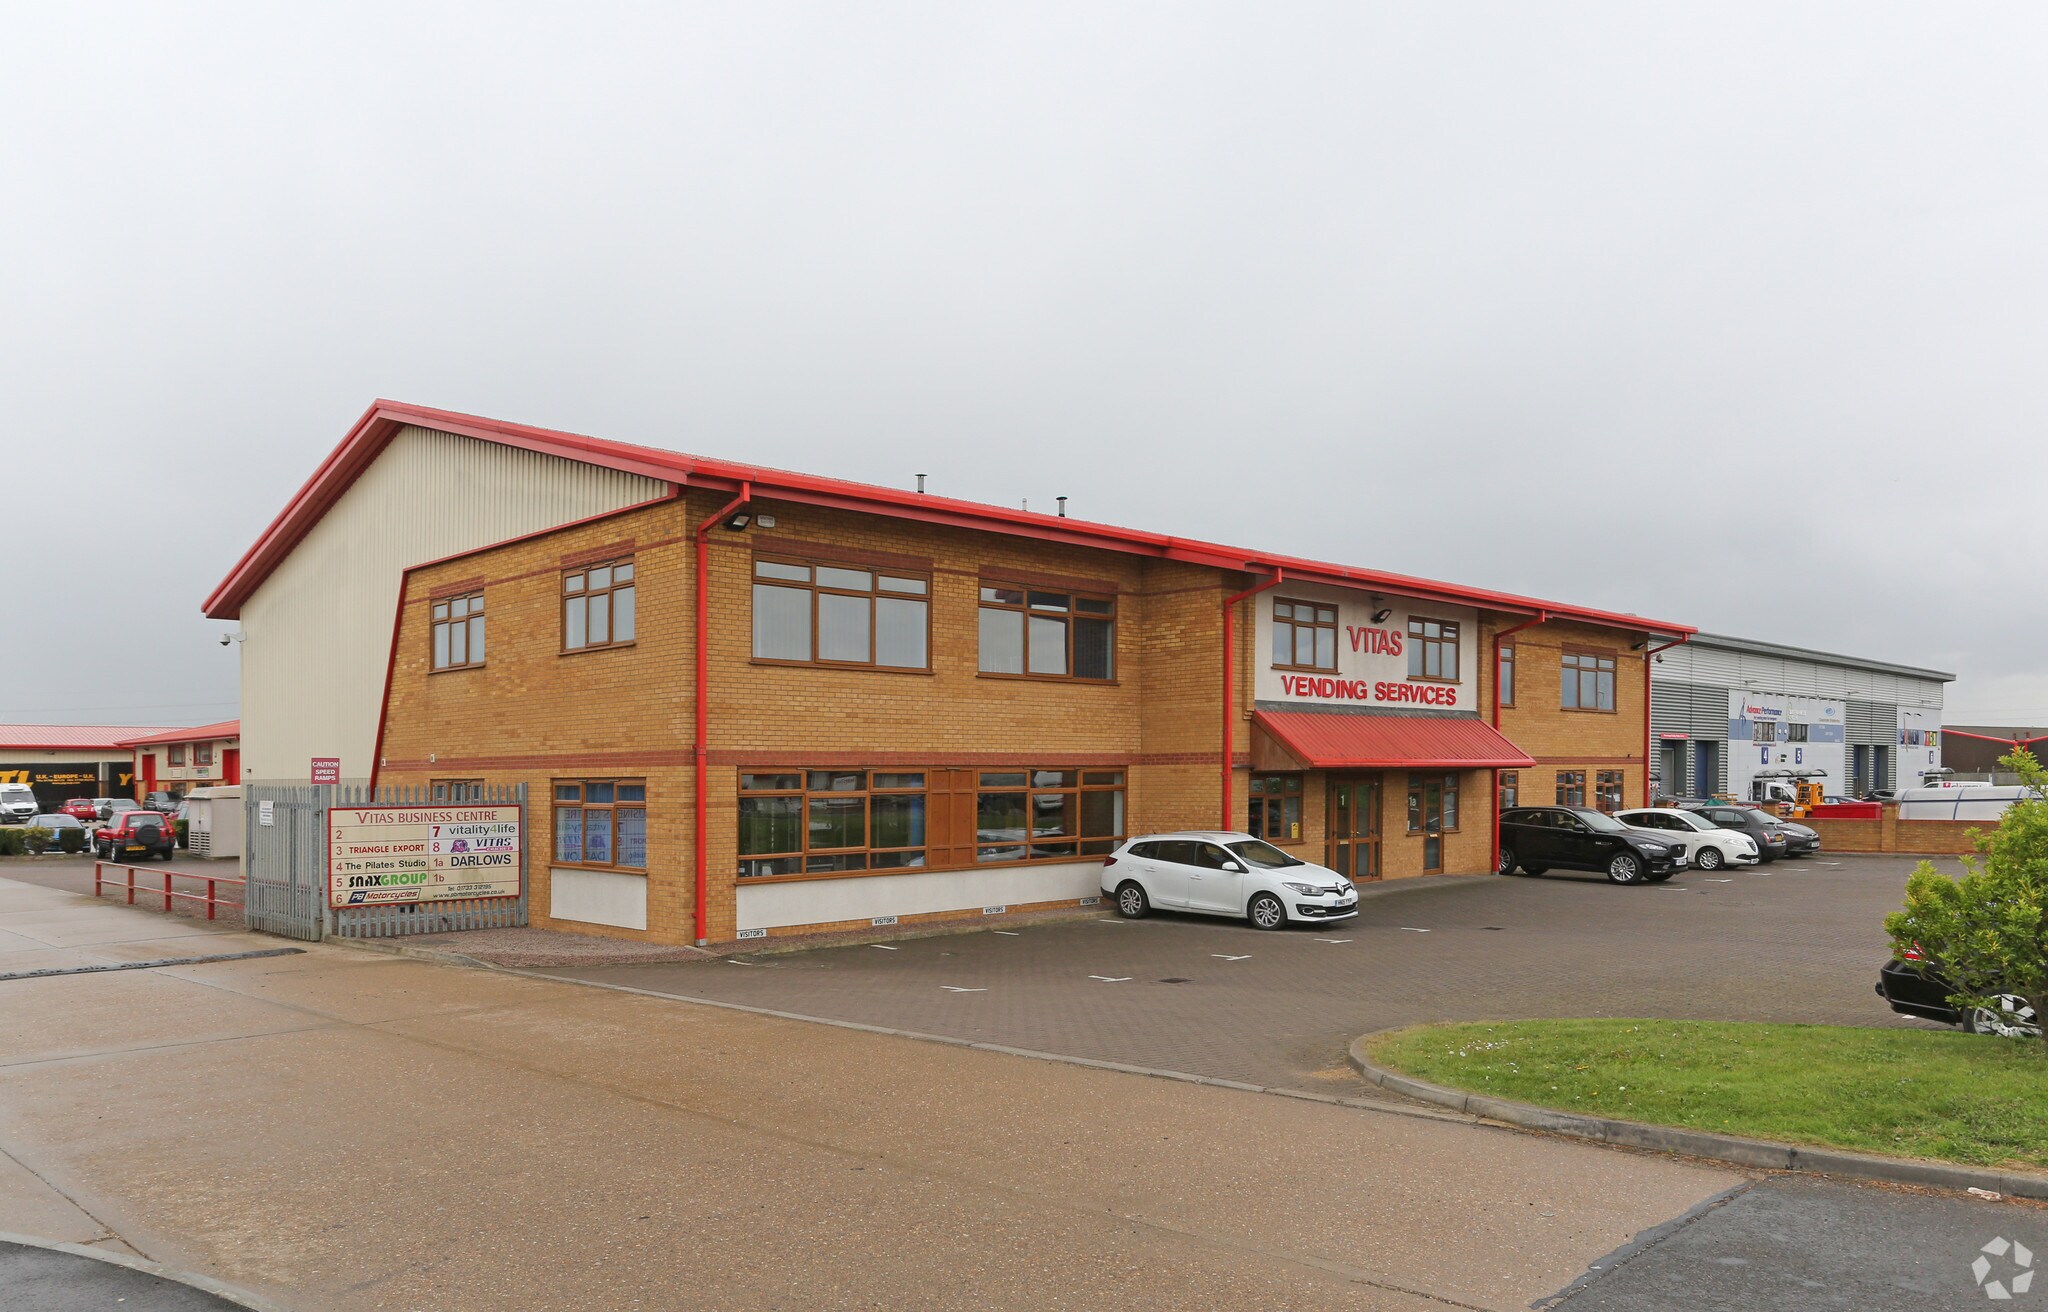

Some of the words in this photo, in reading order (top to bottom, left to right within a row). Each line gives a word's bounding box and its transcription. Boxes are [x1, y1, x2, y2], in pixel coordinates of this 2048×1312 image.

[1346, 626, 1403, 656] VITAS
[1281, 675, 1368, 700] VENDING
[1375, 682, 1457, 706] SERVICES
[355, 812, 394, 824] VITAS
[398, 812, 452, 823] BUSINESS
[456, 810, 497, 821] CENTRE
[335, 830, 343, 839] 2
[432, 825, 441, 838] 7
[449, 824, 516, 836] vitality4life
[335, 846, 343, 856] 3
[349, 845, 390, 854] TRIANGLE
[393, 844, 425, 853] EXPORT
[432, 841, 440, 852] 8
[476, 837, 512, 848] VITAS
[335, 862, 343, 871] 4
[345, 862, 362, 870] The
[365, 861, 395, 870] Pilates
[398, 859, 427, 868] Studio
[433, 858, 444, 867] 1a
[450, 854, 512, 867] DARLOWS
[335, 878, 343, 887] 5
[433, 874, 445, 882] 1b
[335, 894, 343, 903] 6
[365, 890, 418, 900] Motorcycles
[874, 917, 896, 925] VISITORS
[740, 930, 764, 938] VISITORS
